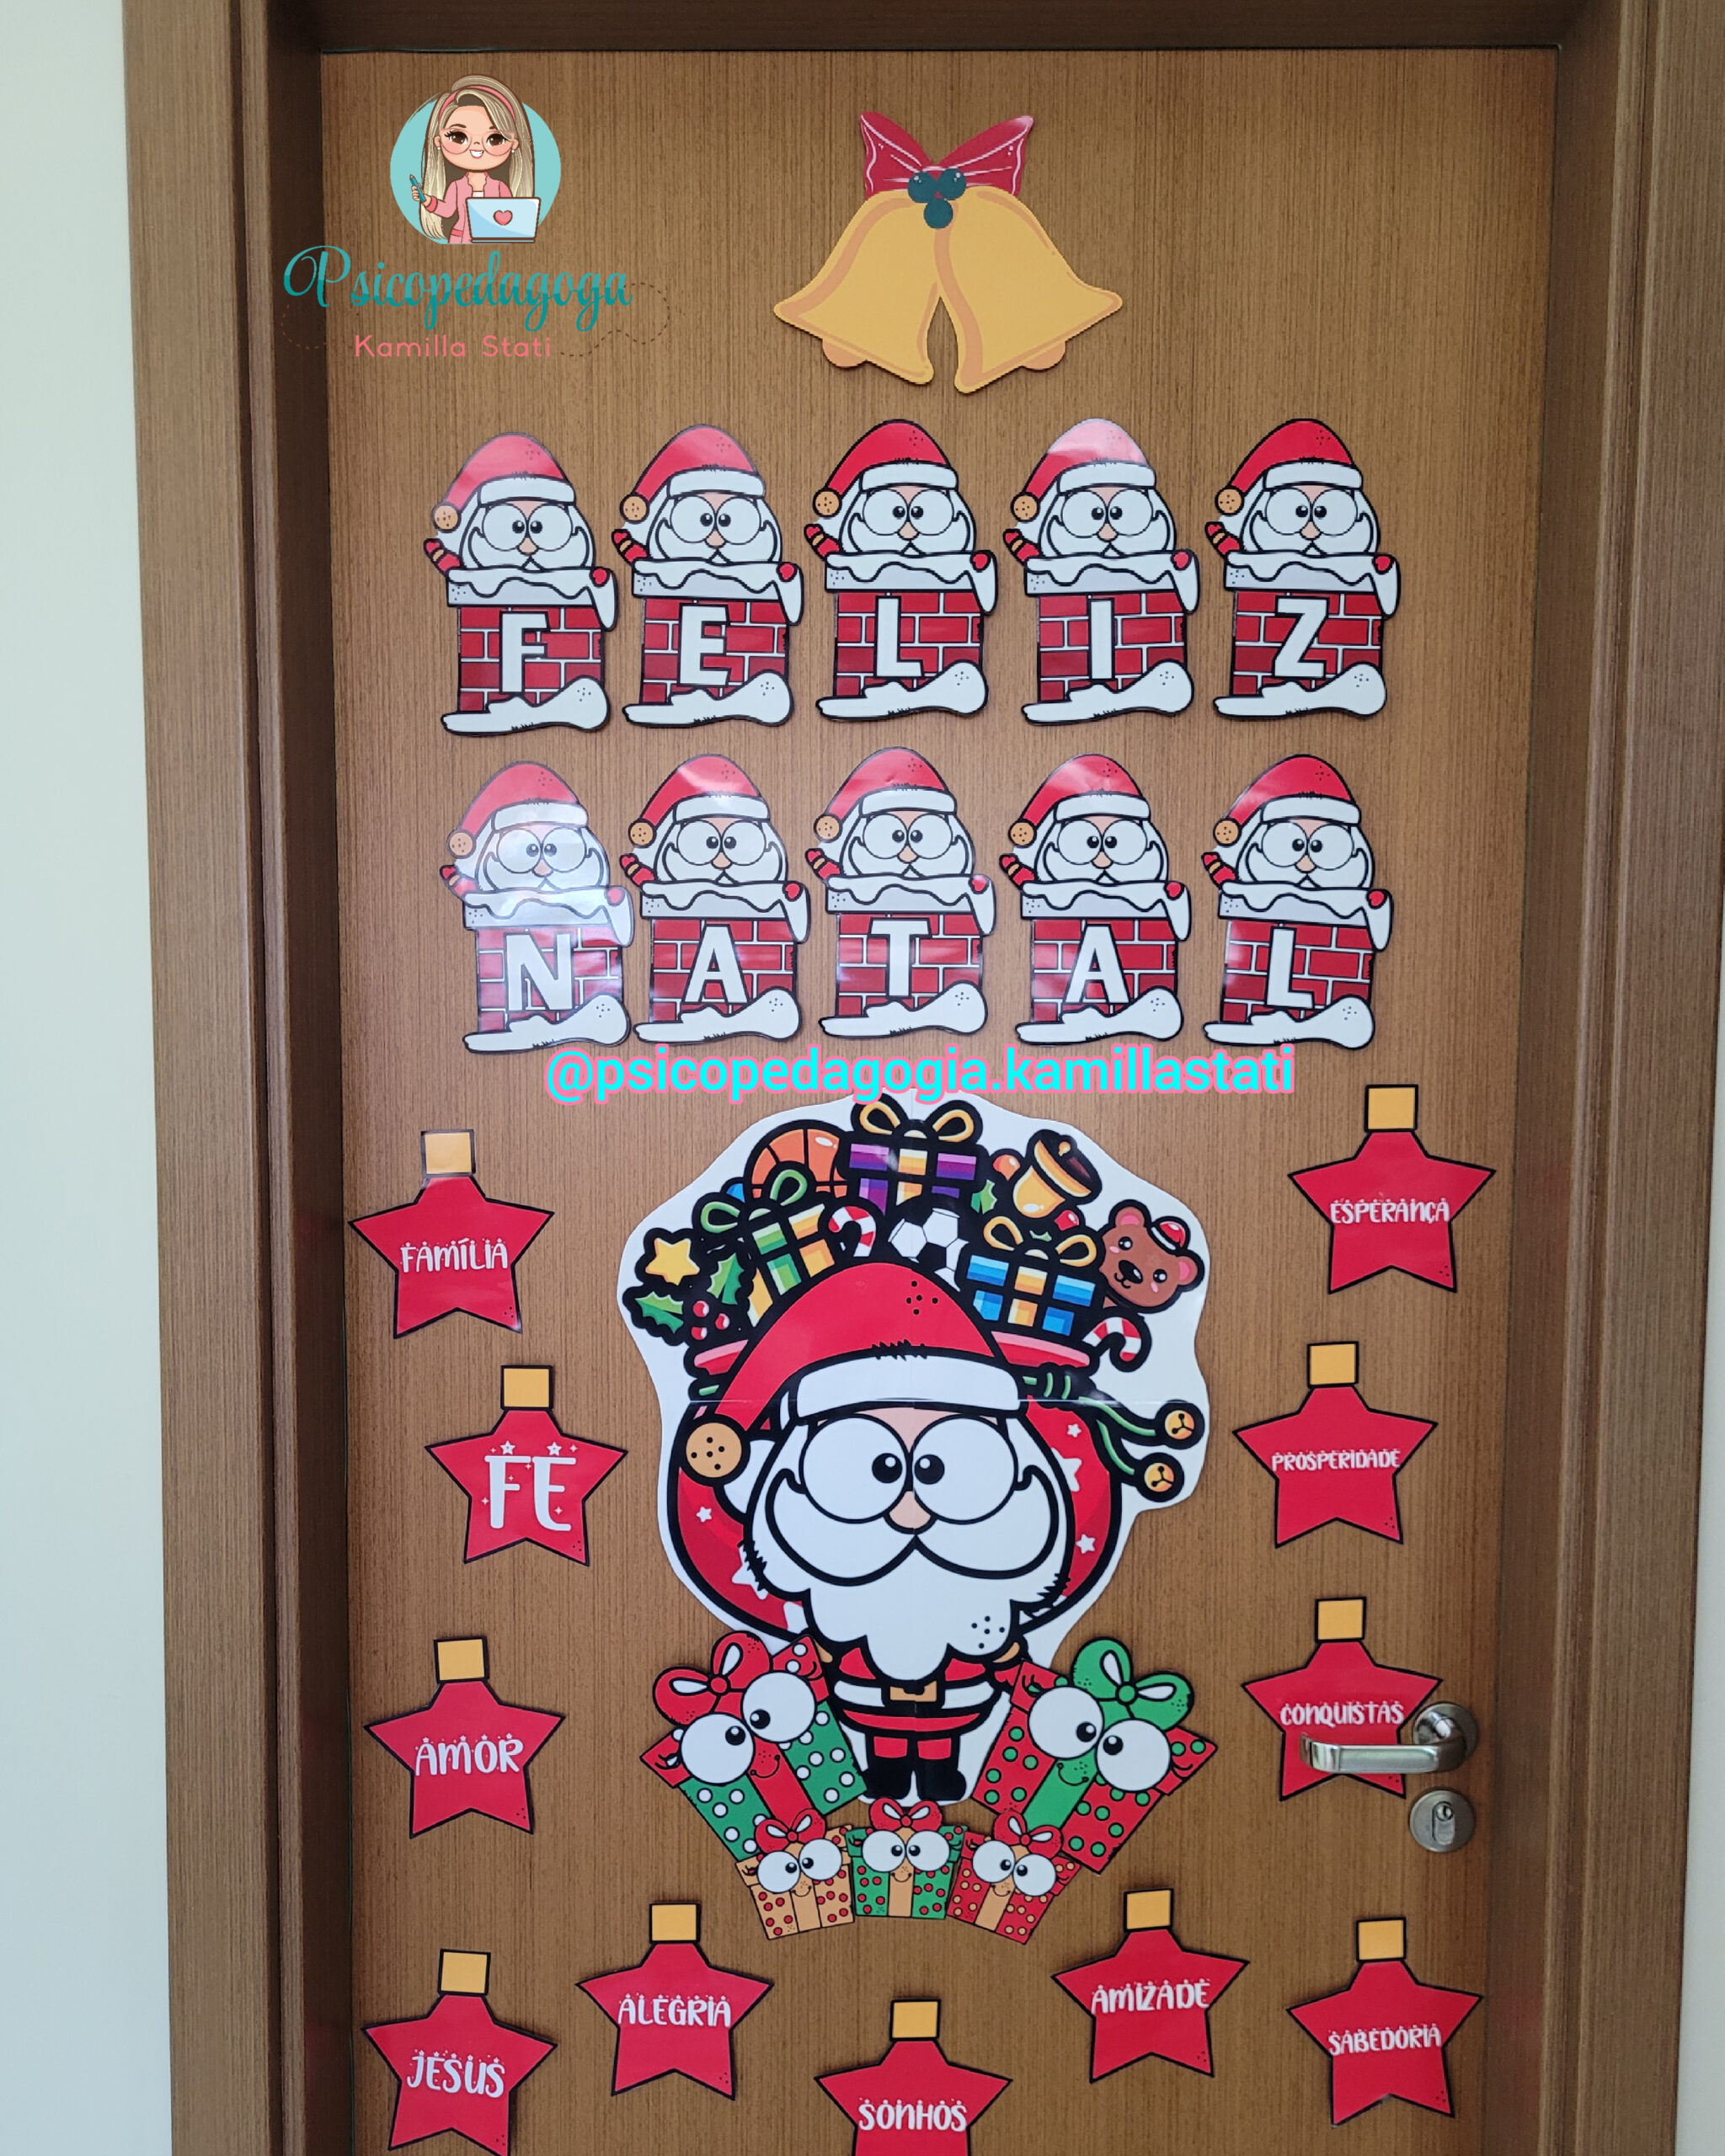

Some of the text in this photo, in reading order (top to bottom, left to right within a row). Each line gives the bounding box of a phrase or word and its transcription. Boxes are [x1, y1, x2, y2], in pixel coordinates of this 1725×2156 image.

[1329, 1199, 1450, 1225] ESPERANÇA
[399, 1237, 509, 1273] FAMÍLIA
[1271, 1449, 1401, 1471] PROSPERIDADE
[1279, 1702, 1405, 1728] CONQUISTAS
[414, 1737, 524, 1776] AMOR
[617, 1995, 732, 2028] ALEGRIA
[1091, 1981, 1211, 2015] AMIZADE
[1327, 2025, 1442, 2057] SABEDORIA
[406, 2054, 505, 2099] JESUS
[857, 2101, 968, 2132] SONHOS
